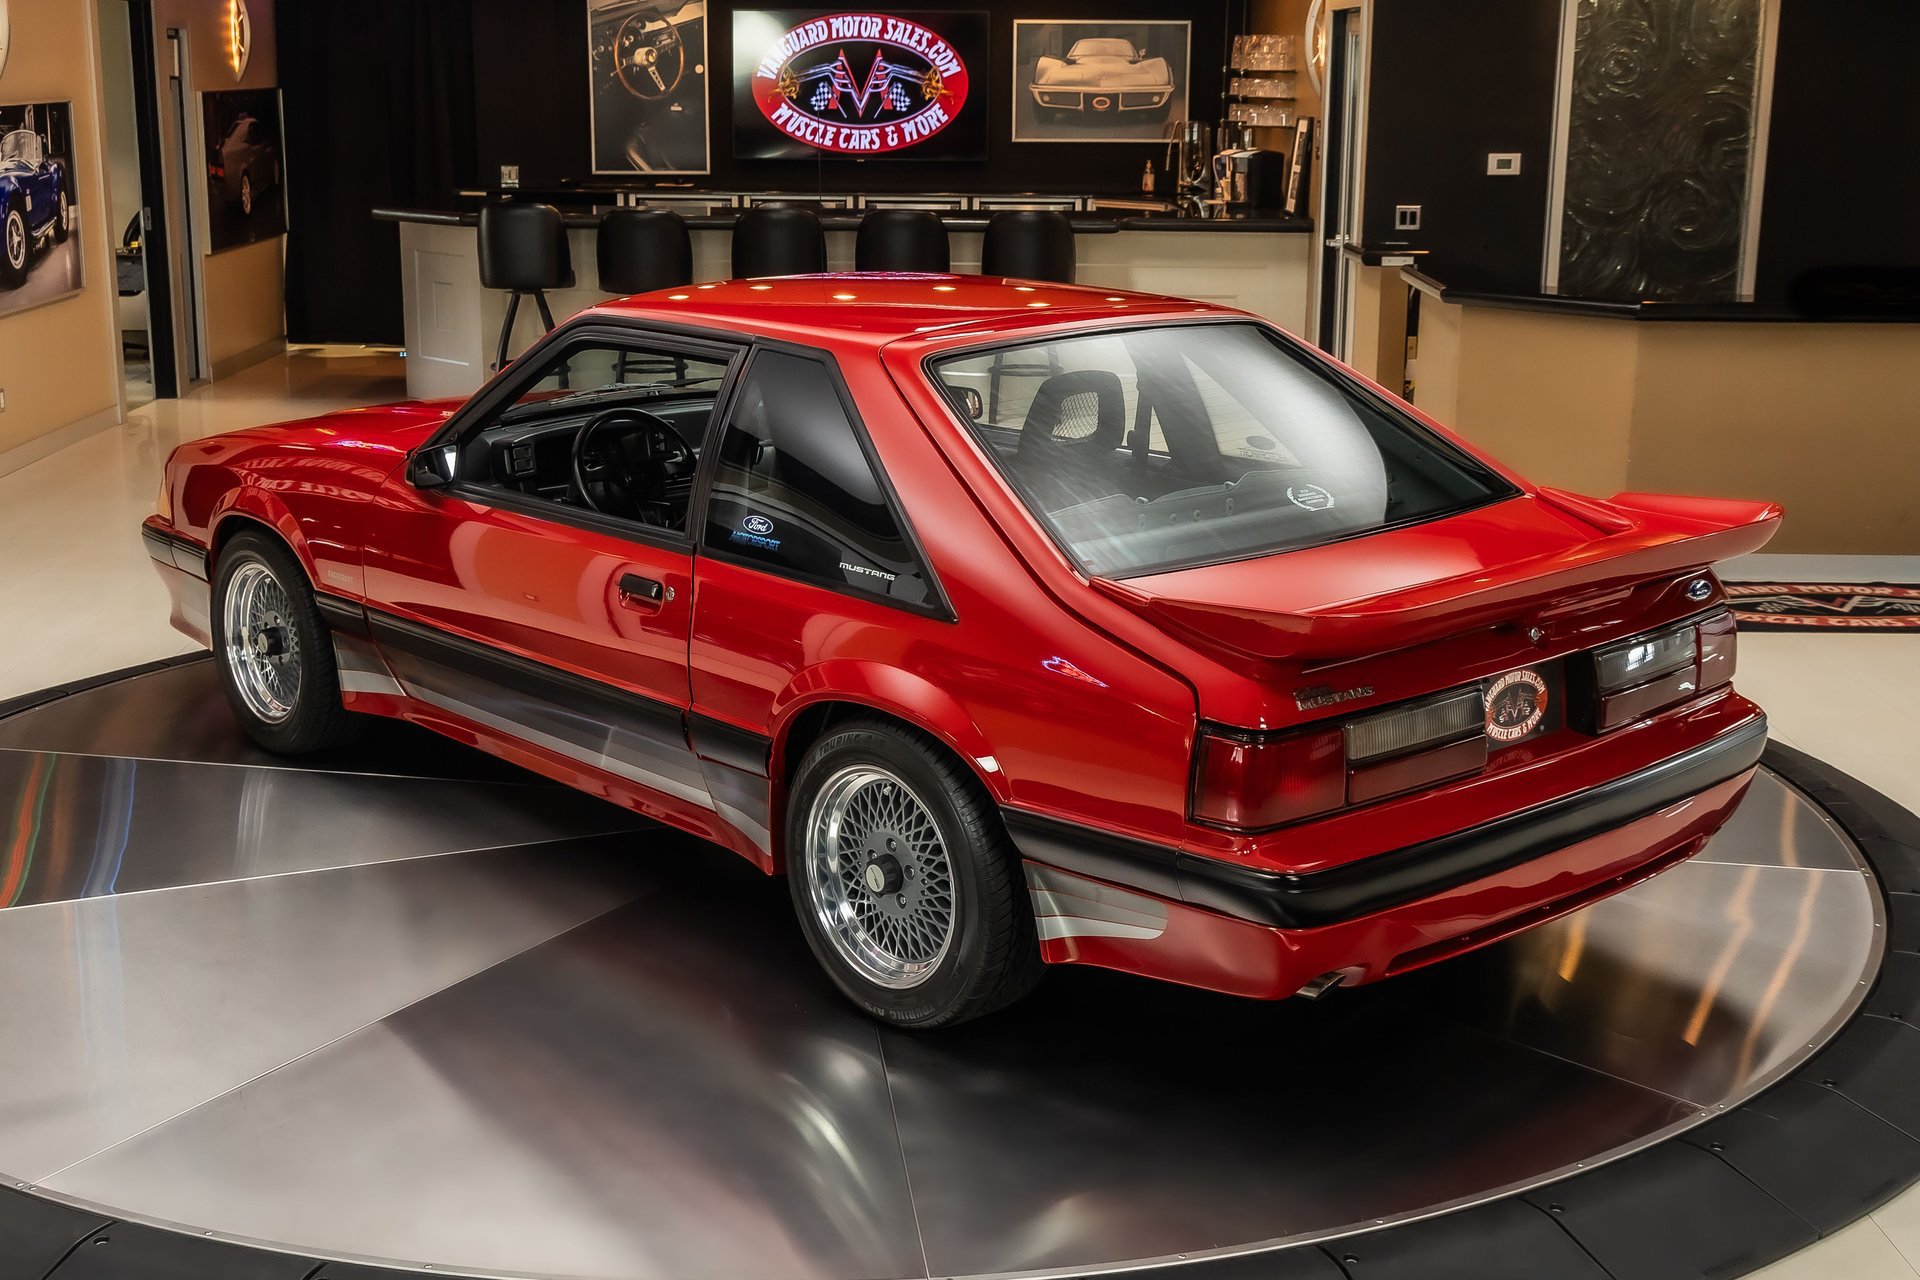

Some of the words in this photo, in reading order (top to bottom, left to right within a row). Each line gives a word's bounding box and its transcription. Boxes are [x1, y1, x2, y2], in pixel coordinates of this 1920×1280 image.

[757, 20, 828, 81] VANGUARD
[829, 16, 882, 39] MOTOR
[884, 18, 962, 79] SALES.COM
[770, 103, 837, 147] MUSCLE
[839, 128, 881, 151] CARS
[885, 126, 899, 146] &
[902, 103, 950, 143] MORE
[748, 518, 769, 532] Ford
[839, 562, 896, 581] MUSTANG
